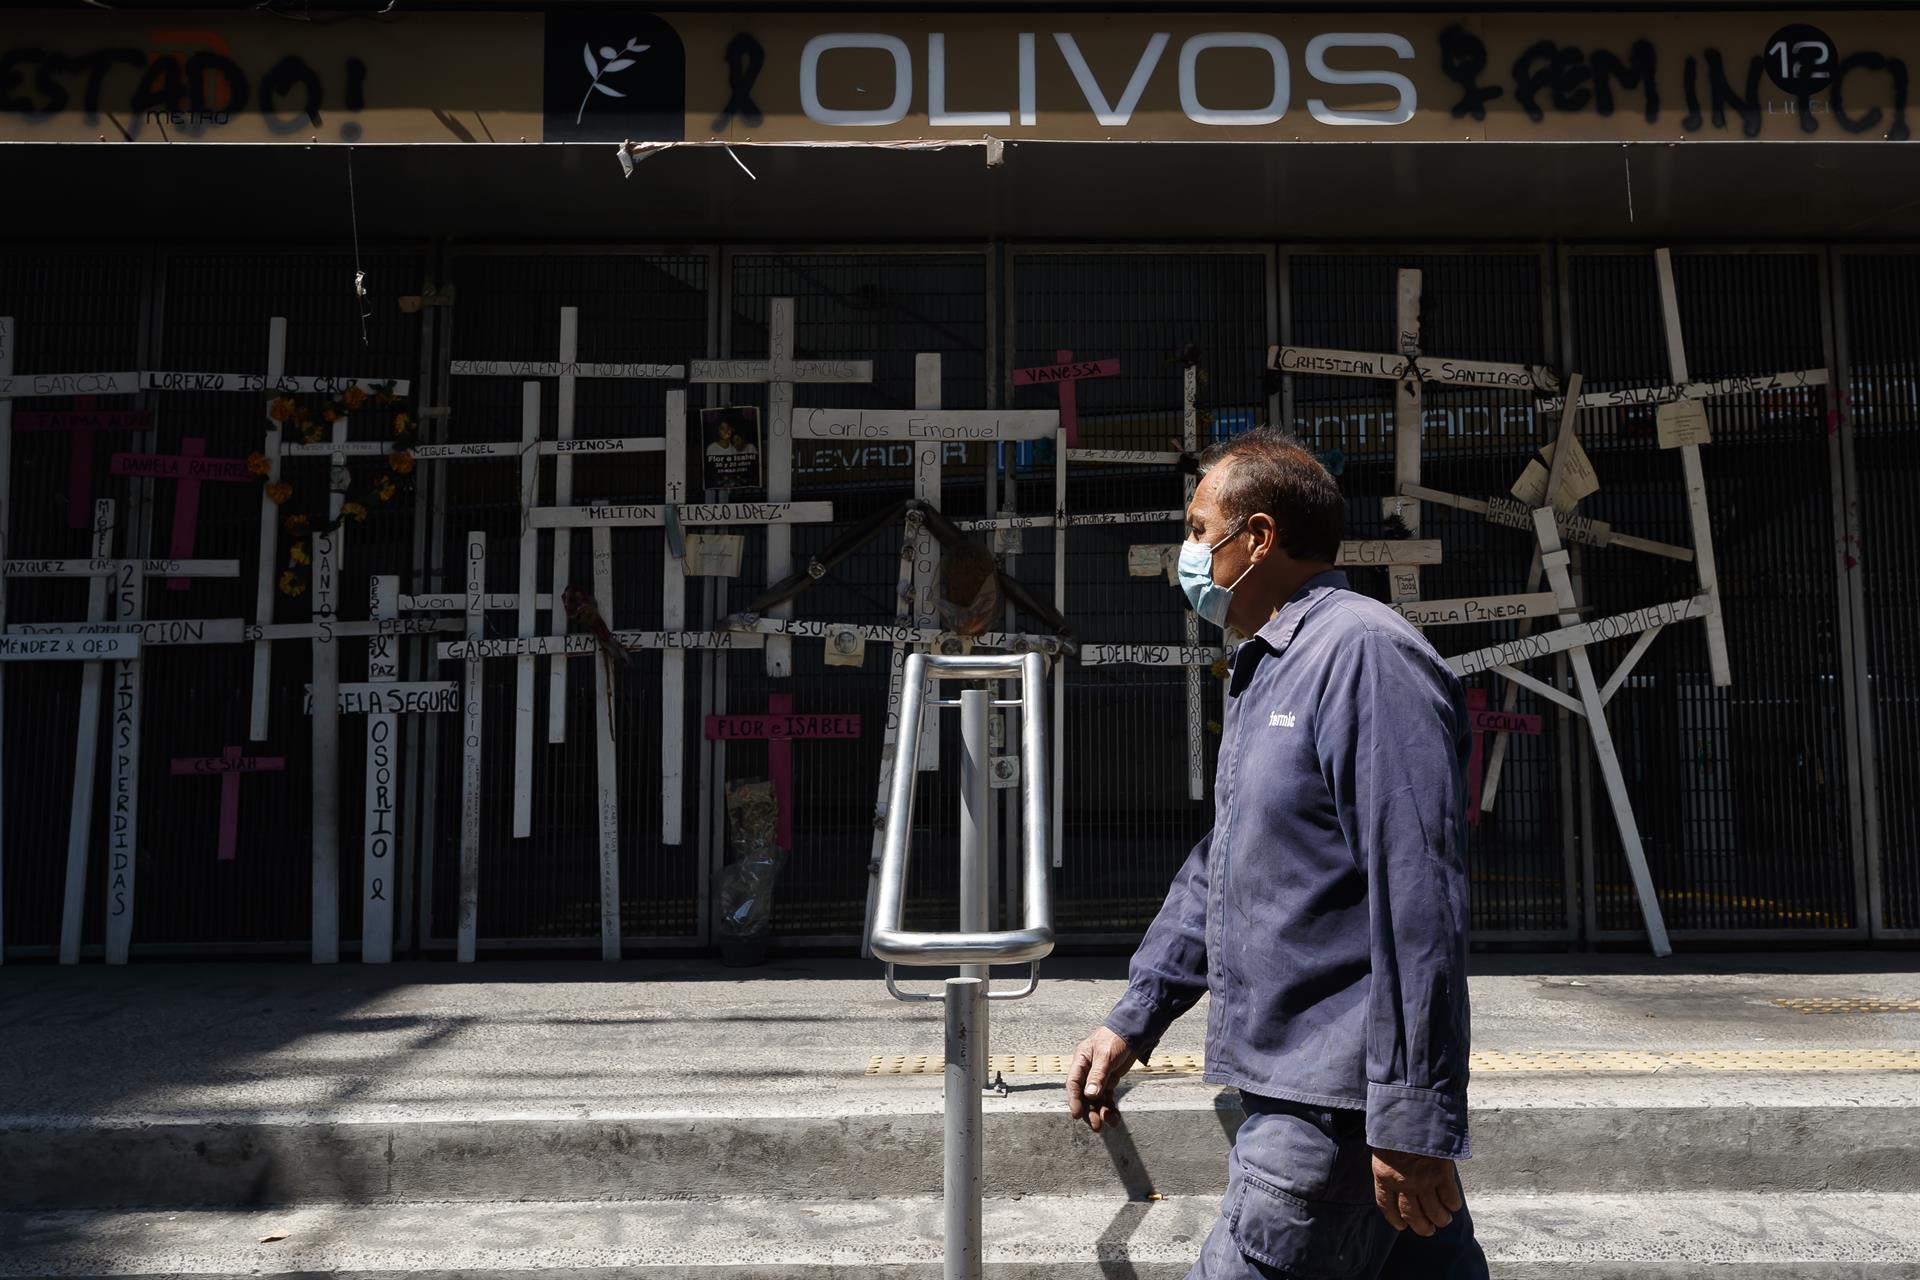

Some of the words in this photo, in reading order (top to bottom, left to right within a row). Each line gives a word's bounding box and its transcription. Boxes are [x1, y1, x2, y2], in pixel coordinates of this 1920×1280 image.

[1767, 40, 1830, 80] 12
[800, 31, 1418, 127] OLIVOS
[146, 109, 229, 125] METRO
[150, 373, 224, 391] LORENZO
[238, 374, 300, 393] ISLAS
[1441, 362, 1529, 386] SANTIAGO
[1607, 384, 1687, 407] SALAZAR
[1704, 373, 1783, 398] JUAREZ
[808, 407, 889, 438] Carlos
[908, 418, 1000, 439] Emanuel
[413, 447, 455, 457] MIGUEL
[460, 444, 495, 455] ANGEL
[556, 439, 624, 452] ESPINOSA
[121, 457, 179, 474] DANIELA
[678, 503, 732, 522] ELASCO
[1342, 541, 1395, 563] EGA
[120, 564, 135, 617] 25
[1464, 600, 1527, 622] PINEDA
[1585, 596, 1698, 643] RODRIGUEZ
[378, 617, 439, 635] PEREZ
[447, 636, 547, 658] GABRIELA
[563, 632, 643, 653] RAMREZ
[653, 631, 733, 649] MEDINA
[1096, 644, 1170, 665] IDELFONSO
[370, 664, 396, 677] PAZ
[717, 719, 763, 737] FLOR
[770, 722, 783, 735] e
[784, 717, 858, 737] ISABEL
[371, 720, 393, 858] OSORIO
[112, 755, 131, 917] PERDIDAS
